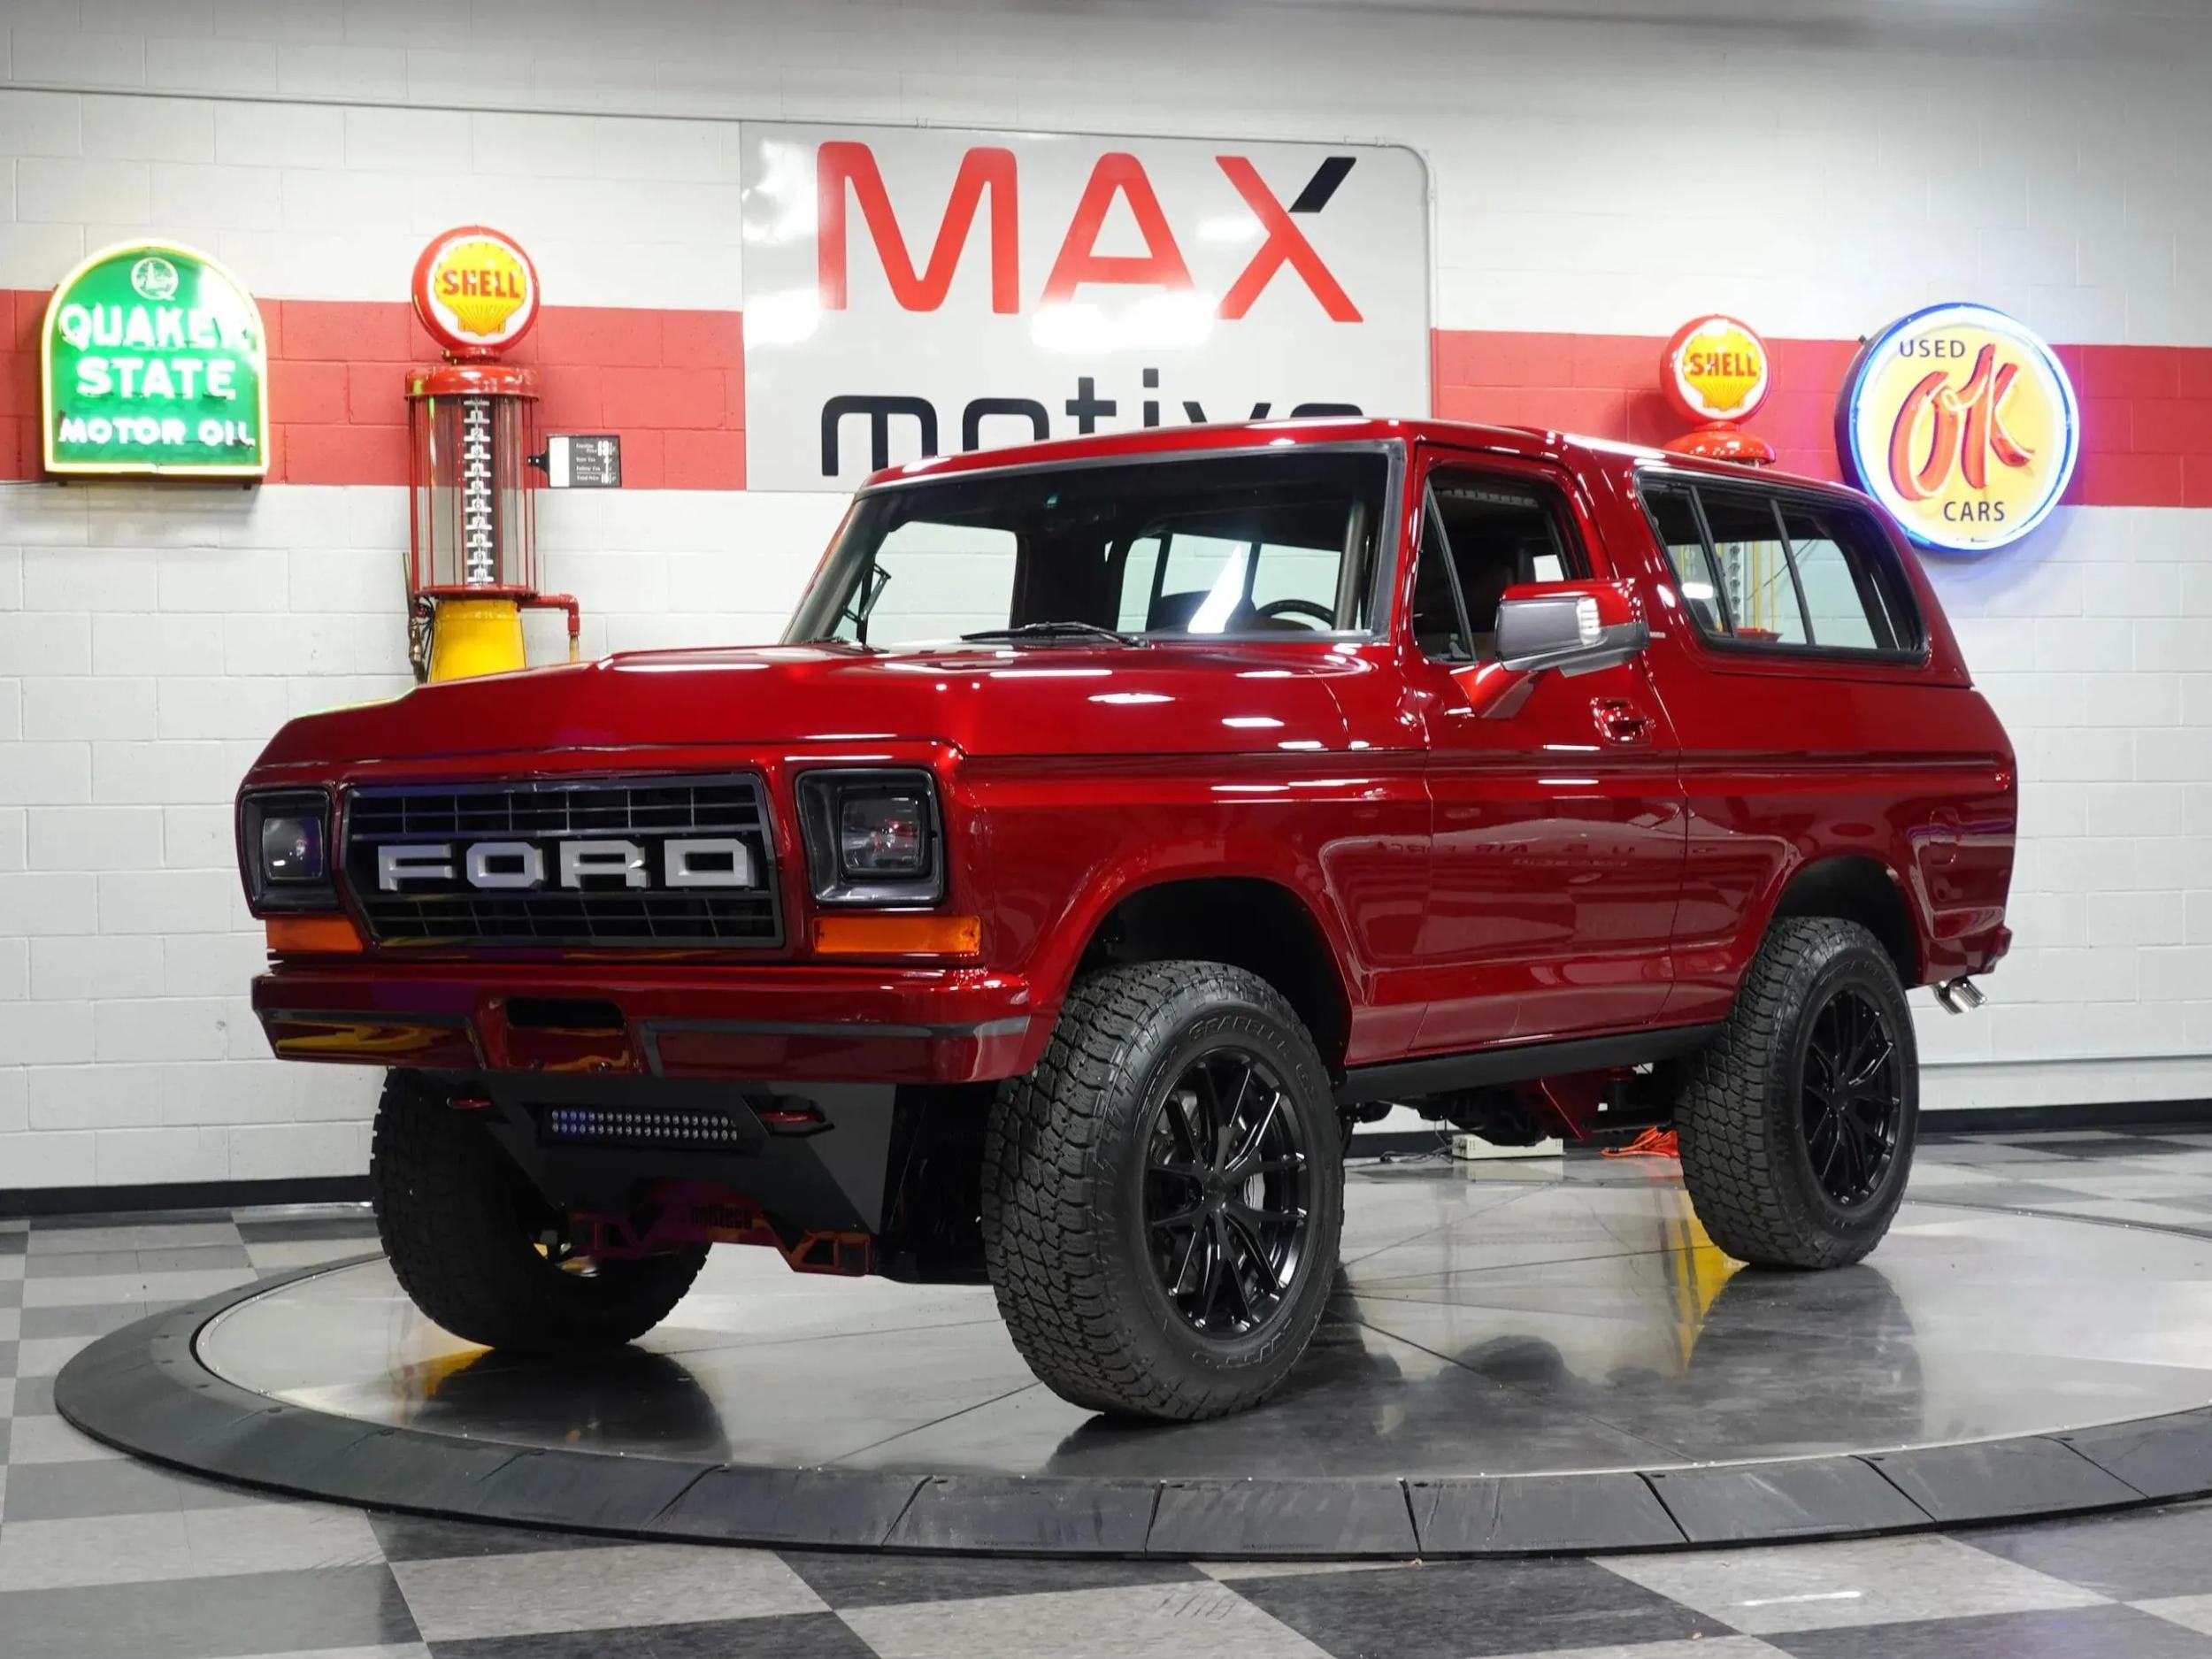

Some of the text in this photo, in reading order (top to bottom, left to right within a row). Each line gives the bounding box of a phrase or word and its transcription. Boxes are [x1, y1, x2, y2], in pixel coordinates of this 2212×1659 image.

[817, 141, 1363, 323] MAX
[442, 268, 520, 299] SHELL
[1689, 352, 1757, 377] SHELL
[1900, 339, 1966, 358] USED
[76, 357, 237, 400] STATE
[58, 417, 256, 449] MOTOR OIL
[1888, 343, 2036, 501] OK
[1943, 501, 2005, 522] CARS
[378, 838, 759, 891] FORD
